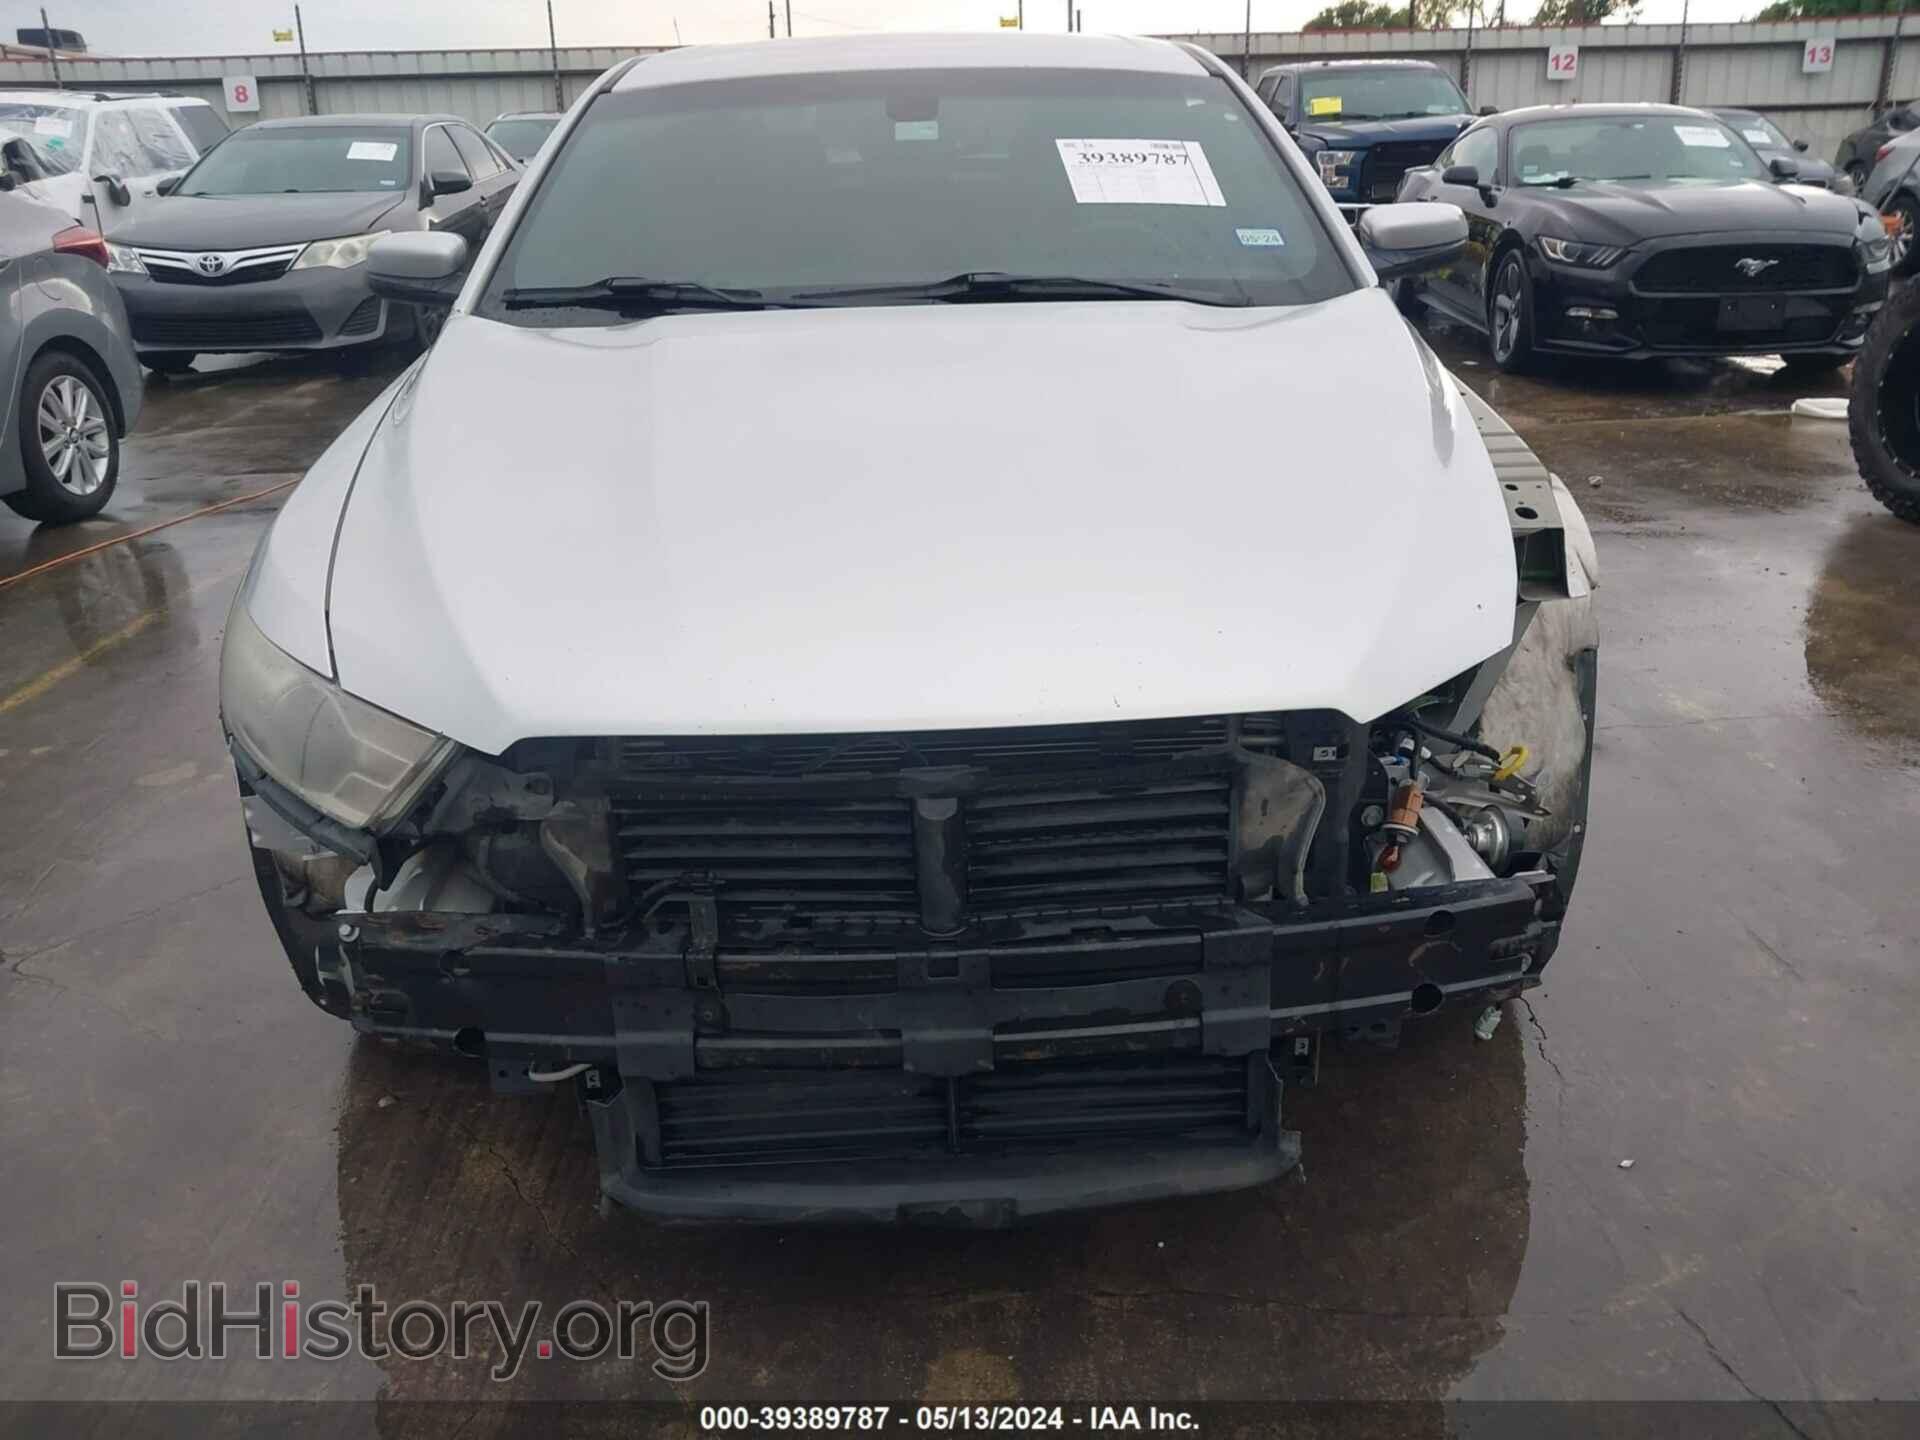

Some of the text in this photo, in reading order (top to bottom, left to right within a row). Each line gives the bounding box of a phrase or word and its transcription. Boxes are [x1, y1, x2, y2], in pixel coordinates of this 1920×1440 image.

[1551, 54, 1575, 71] 12
[1808, 47, 1831, 64] 13
[235, 84, 249, 104] 8
[1077, 152, 1190, 166] 39389787
